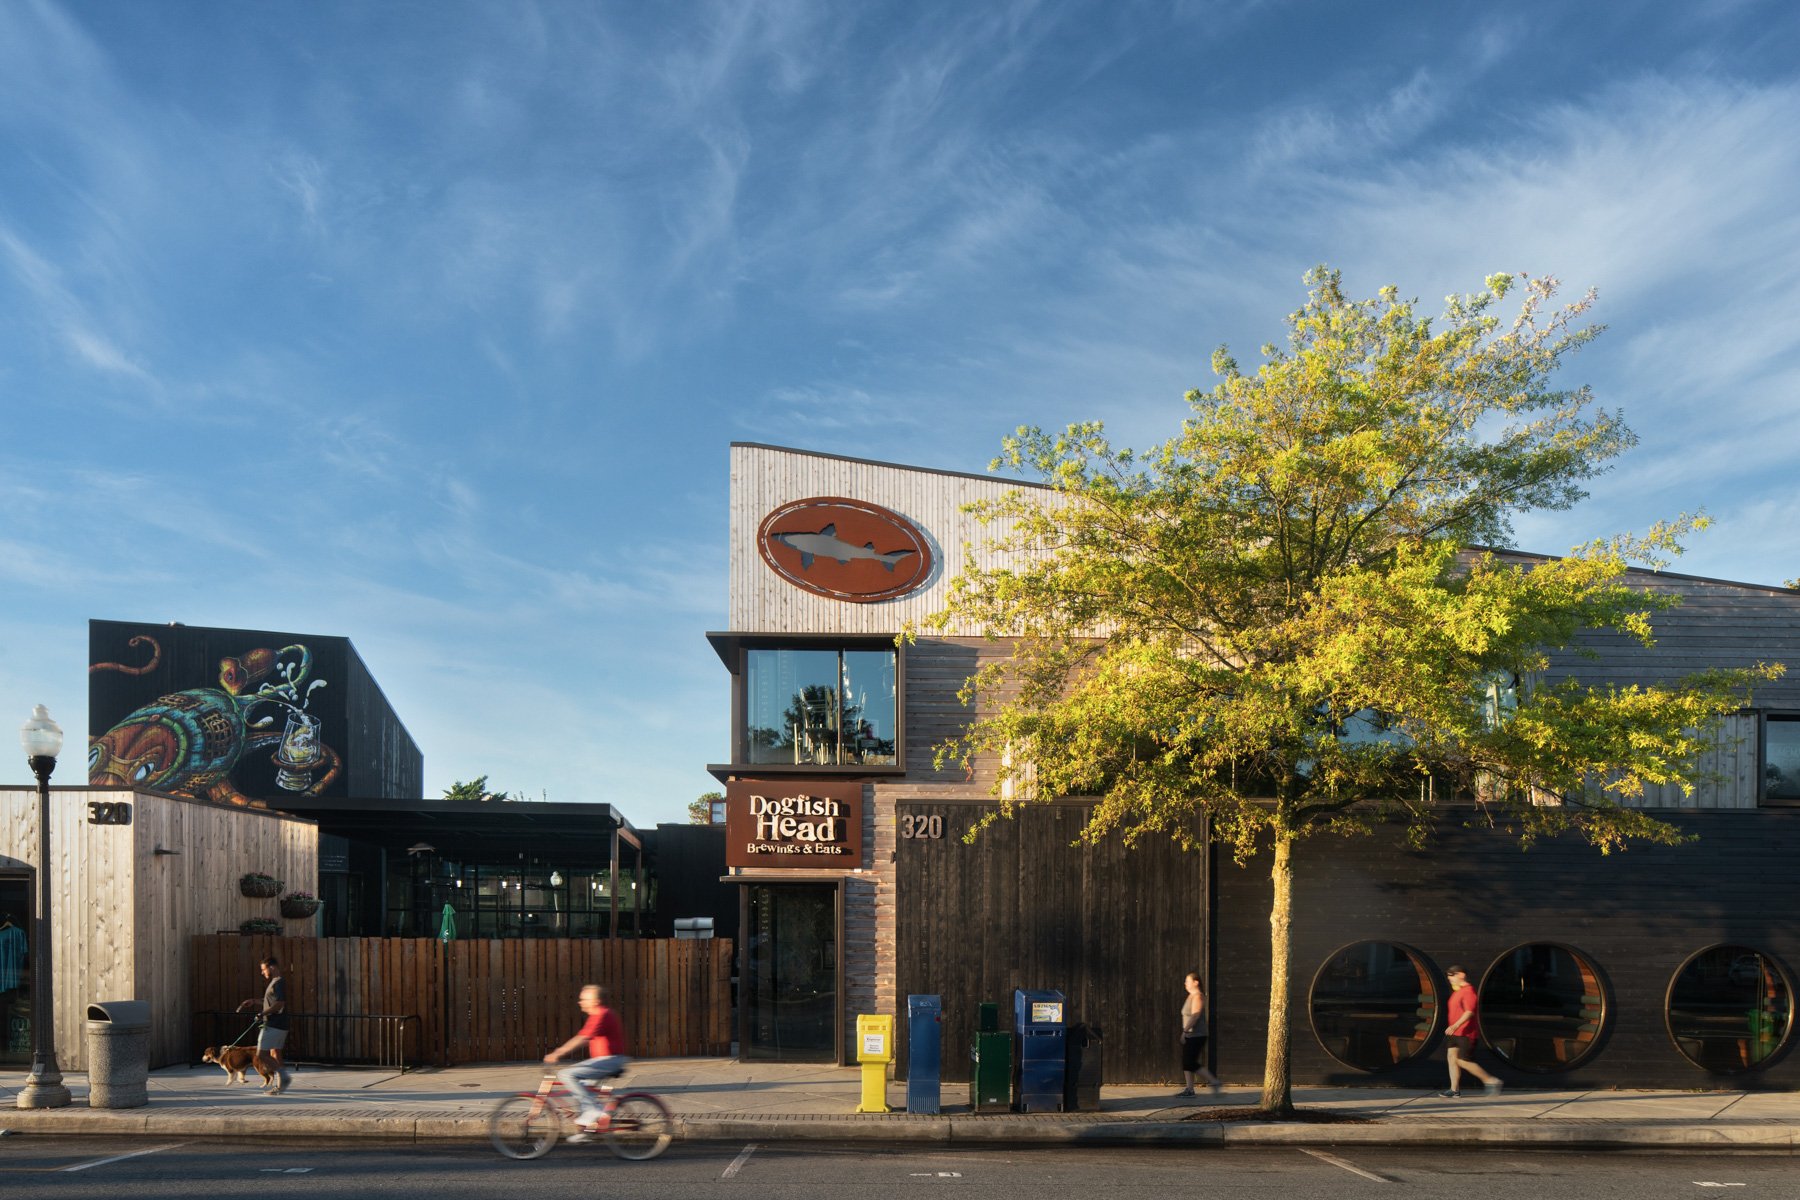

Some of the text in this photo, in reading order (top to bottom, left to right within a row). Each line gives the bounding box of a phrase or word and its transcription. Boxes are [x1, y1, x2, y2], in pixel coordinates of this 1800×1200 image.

[88, 802, 130, 825] 320
[750, 794, 839, 816] Dogfish
[756, 815, 835, 841] Head
[901, 815, 942, 838] 320
[747, 843, 841, 854] Brewings & Eats
